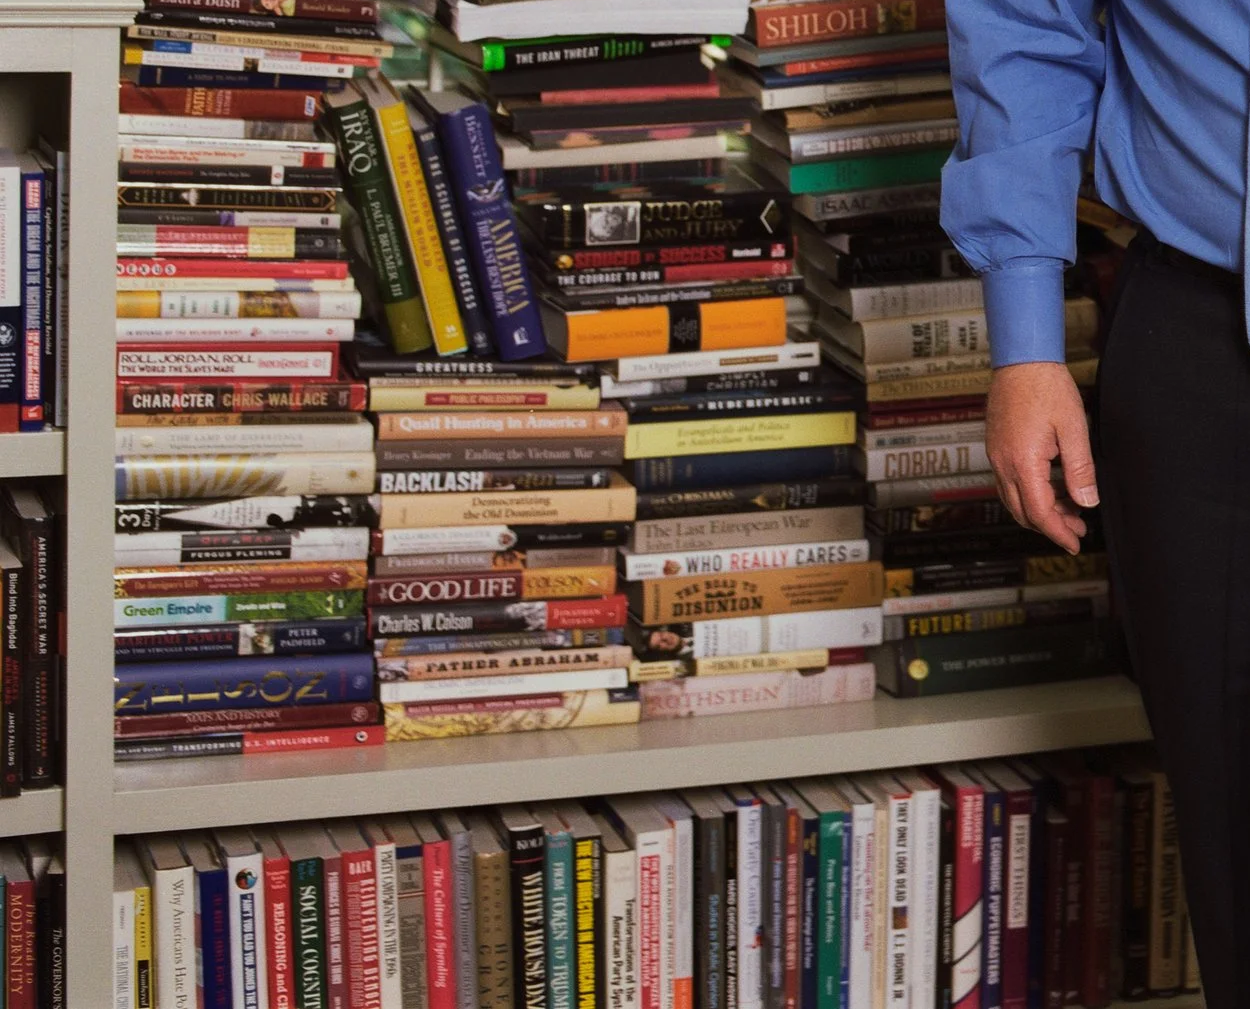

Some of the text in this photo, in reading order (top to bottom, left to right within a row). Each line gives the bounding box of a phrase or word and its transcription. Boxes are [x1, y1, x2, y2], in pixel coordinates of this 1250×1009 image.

[766, 8, 869, 40] SHILOH
[516, 46, 599, 62] THE IRAN THREAT
[340, 111, 372, 176] IRAQ
[644, 200, 723, 221] JUDGE
[26, 210, 40, 330] THE DREAM AND THE NIGHTMARE
[490, 218, 530, 314] AMERICA
[121, 365, 136, 373] THE
[138, 365, 166, 373] WORLD
[214, 365, 235, 373] MADE
[416, 362, 494, 373] GREATNESS
[133, 392, 328, 408] CHARACTER CHRIS WALLACE
[707, 379, 778, 391] CHRISTIAN
[400, 416, 587, 433] Quail Hunting in America
[464, 448, 594, 461] Ending the Vietnam War
[885, 446, 970, 478] COBRA II
[381, 472, 485, 492] BACKLASH
[646, 516, 812, 538] The Last European War
[686, 546, 847, 573] WHO REALLY CARES
[38, 537, 47, 655] AMERICA'S SECRET WAR
[388, 577, 516, 603] GOOD LIFE
[527, 576, 585, 589] COLSON
[7, 573, 18, 649] Blind Into Baghdad
[124, 603, 212, 616] Green Empire
[553, 607, 600, 618] JONATHAN
[672, 596, 763, 617] DISUNION
[288, 629, 318, 637] PETER
[378, 613, 473, 633] Charles W. Colson
[908, 613, 972, 636] FUTURE
[280, 638, 325, 647] PADFIELD
[426, 653, 599, 672] FATHER ABRAHAM
[651, 685, 780, 710] ROTHSTEIN
[7, 712, 15, 766] JAMES FALLOWS
[961, 795, 972, 848] PRIMARIES
[381, 851, 394, 875] PARTY
[896, 802, 908, 901] THEY ONLY LOOK DEAD
[745, 809, 761, 927] One Party Country
[1012, 824, 1027, 919] FIRST THINGS
[382, 876, 395, 927] CAMPAIGNING
[550, 862, 568, 959] FROM TOKEN TO
[577, 841, 595, 992] THE NEW DIRECTION IN AMERICAN
[988, 836, 1001, 985] ECONOMIC PUPPETMASTERS
[169, 880, 186, 992] Why Americans Hate
[360, 878, 377, 962] REINVENTING
[433, 869, 448, 988] The Culture of Spending
[523, 872, 546, 982] WHITE HOUSE
[10, 895, 23, 995] MODERNITY
[26, 903, 35, 984] The Roads to
[53, 929, 62, 944] The
[273, 903, 287, 971] REASONING
[384, 938, 396, 956] THE
[610, 916, 624, 985] American Party
[624, 899, 637, 1002] Transformations of the
[709, 895, 721, 1009] Studies in Public Opinion
[116, 946, 129, 995] THE RATIONAL
[276, 974, 288, 992] and
